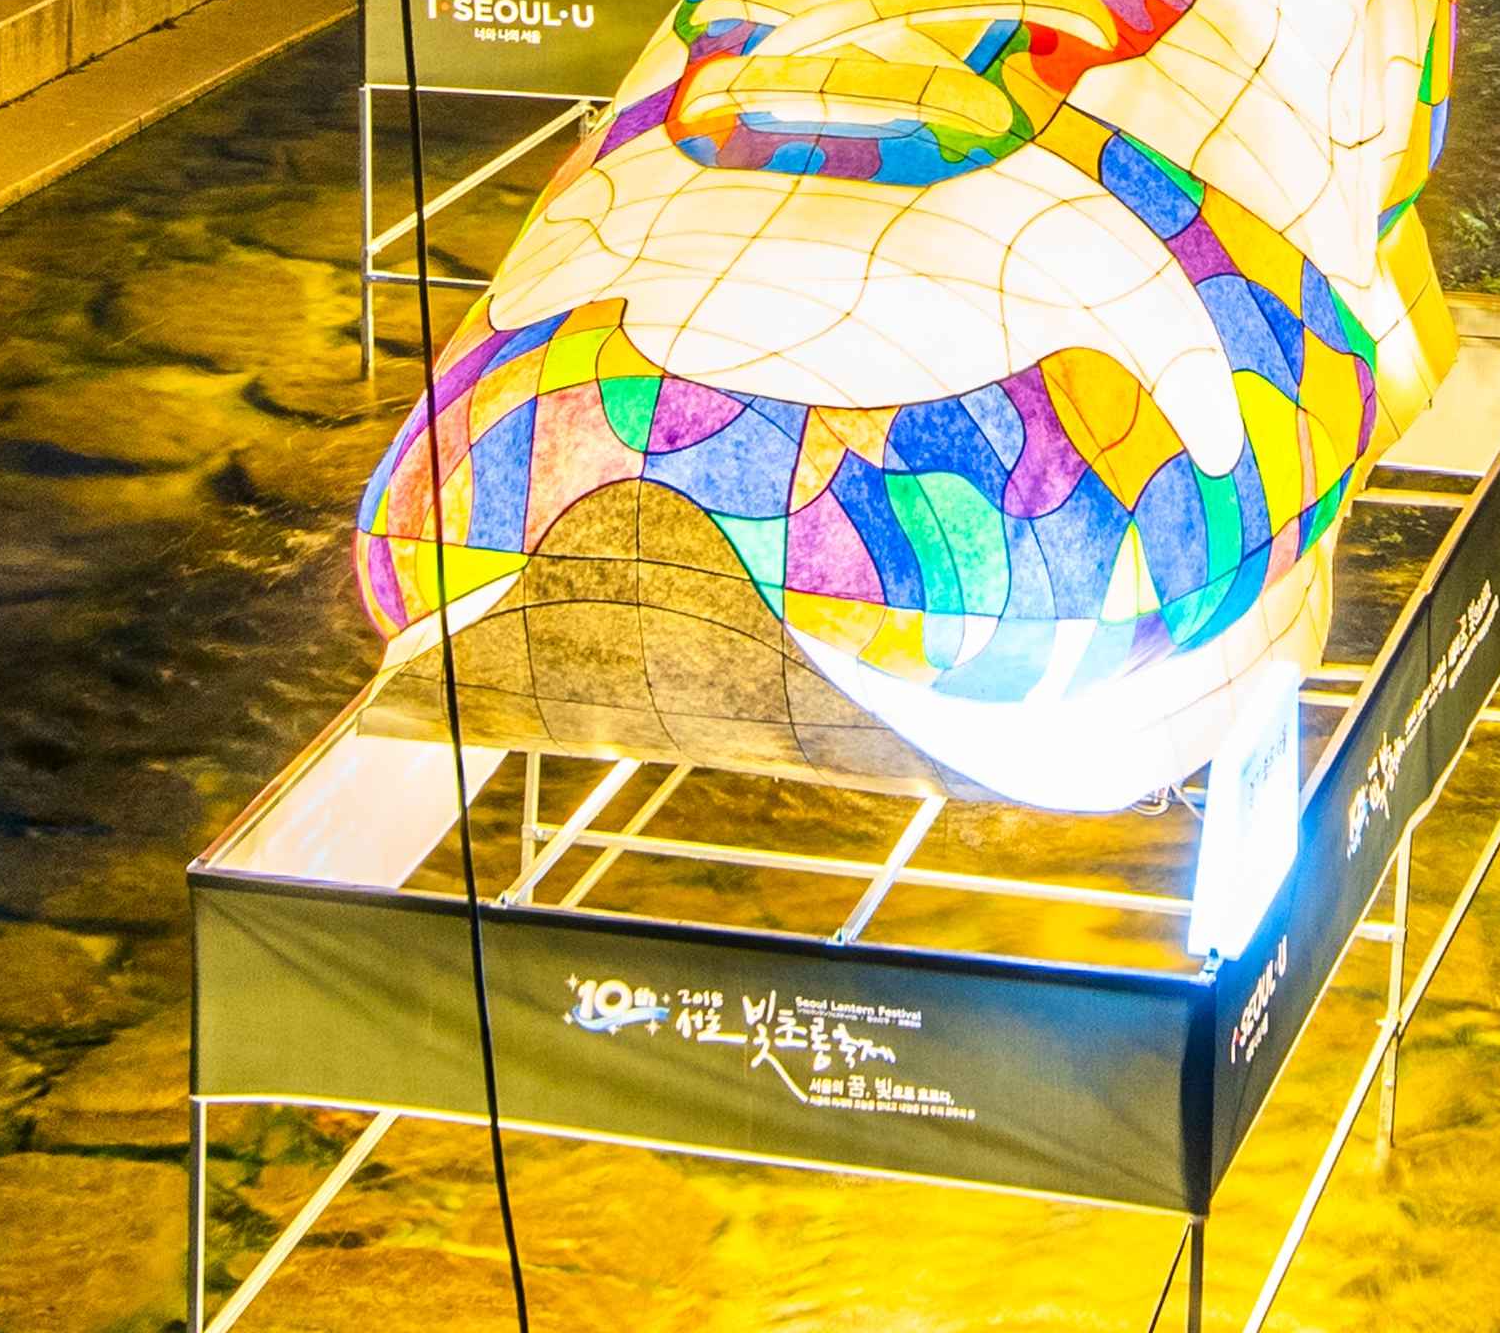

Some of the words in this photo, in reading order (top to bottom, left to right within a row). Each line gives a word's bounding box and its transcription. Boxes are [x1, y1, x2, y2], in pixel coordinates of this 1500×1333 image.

[576, 979, 658, 1020] 10th
[677, 989, 724, 1007] 2018
[795, 996, 827, 1011] Seoul
[830, 999, 874, 1017] Lantern
[878, 1004, 922, 1023] Festival
[742, 989, 897, 1103] 빛초롱축제
[809, 1077, 844, 1097] 서울의
